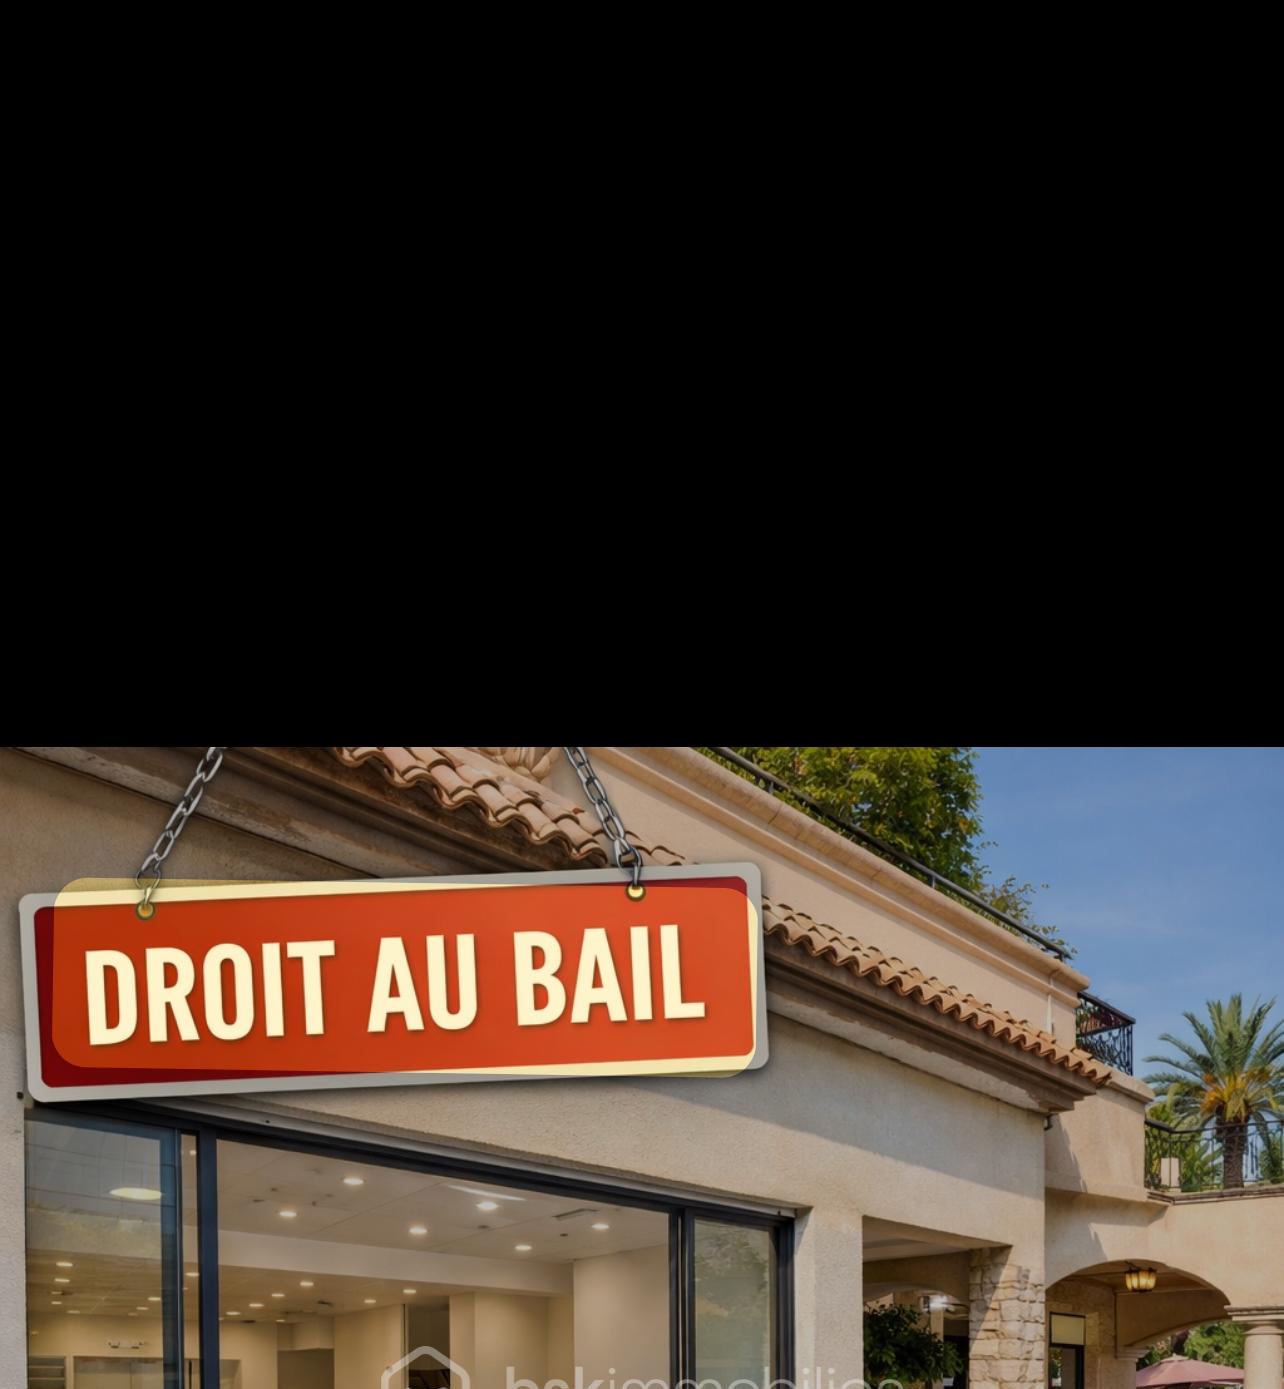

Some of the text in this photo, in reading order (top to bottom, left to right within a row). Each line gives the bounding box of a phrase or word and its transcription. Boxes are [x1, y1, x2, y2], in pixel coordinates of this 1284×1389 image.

[85, 924, 706, 1046] DROIT AU BAIL
